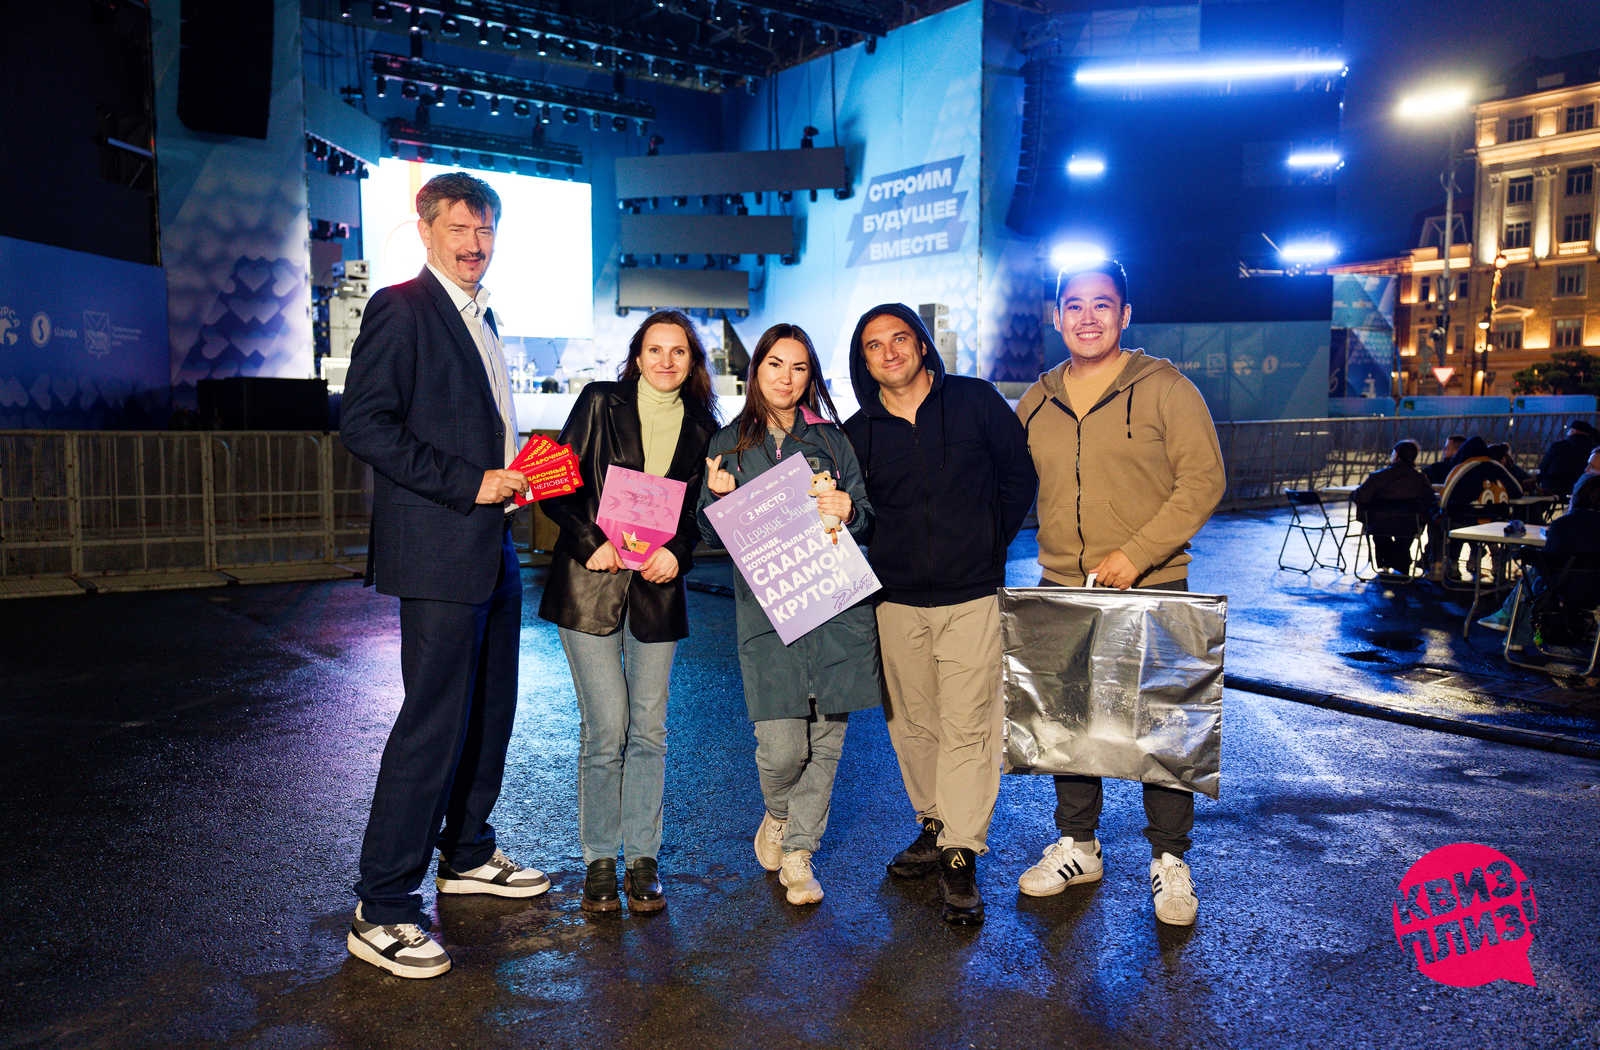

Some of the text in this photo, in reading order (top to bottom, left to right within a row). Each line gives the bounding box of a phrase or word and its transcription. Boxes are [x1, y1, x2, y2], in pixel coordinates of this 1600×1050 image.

[869, 167, 952, 203] СТРОИМ
[863, 198, 958, 233] БУДУЩЕЕ
[869, 231, 949, 261] ВМЕСТЕ
[533, 476, 570, 490] ЧЕЛОВЕК
[746, 511, 756, 521] 2
[754, 492, 787, 516] МЕСТО
[741, 537, 783, 564] КОМАНДЕ,
[745, 546, 782, 571] КОТОРАЯ
[781, 532, 806, 551] БЫЛА
[772, 567, 850, 624] КРУТОЙ
